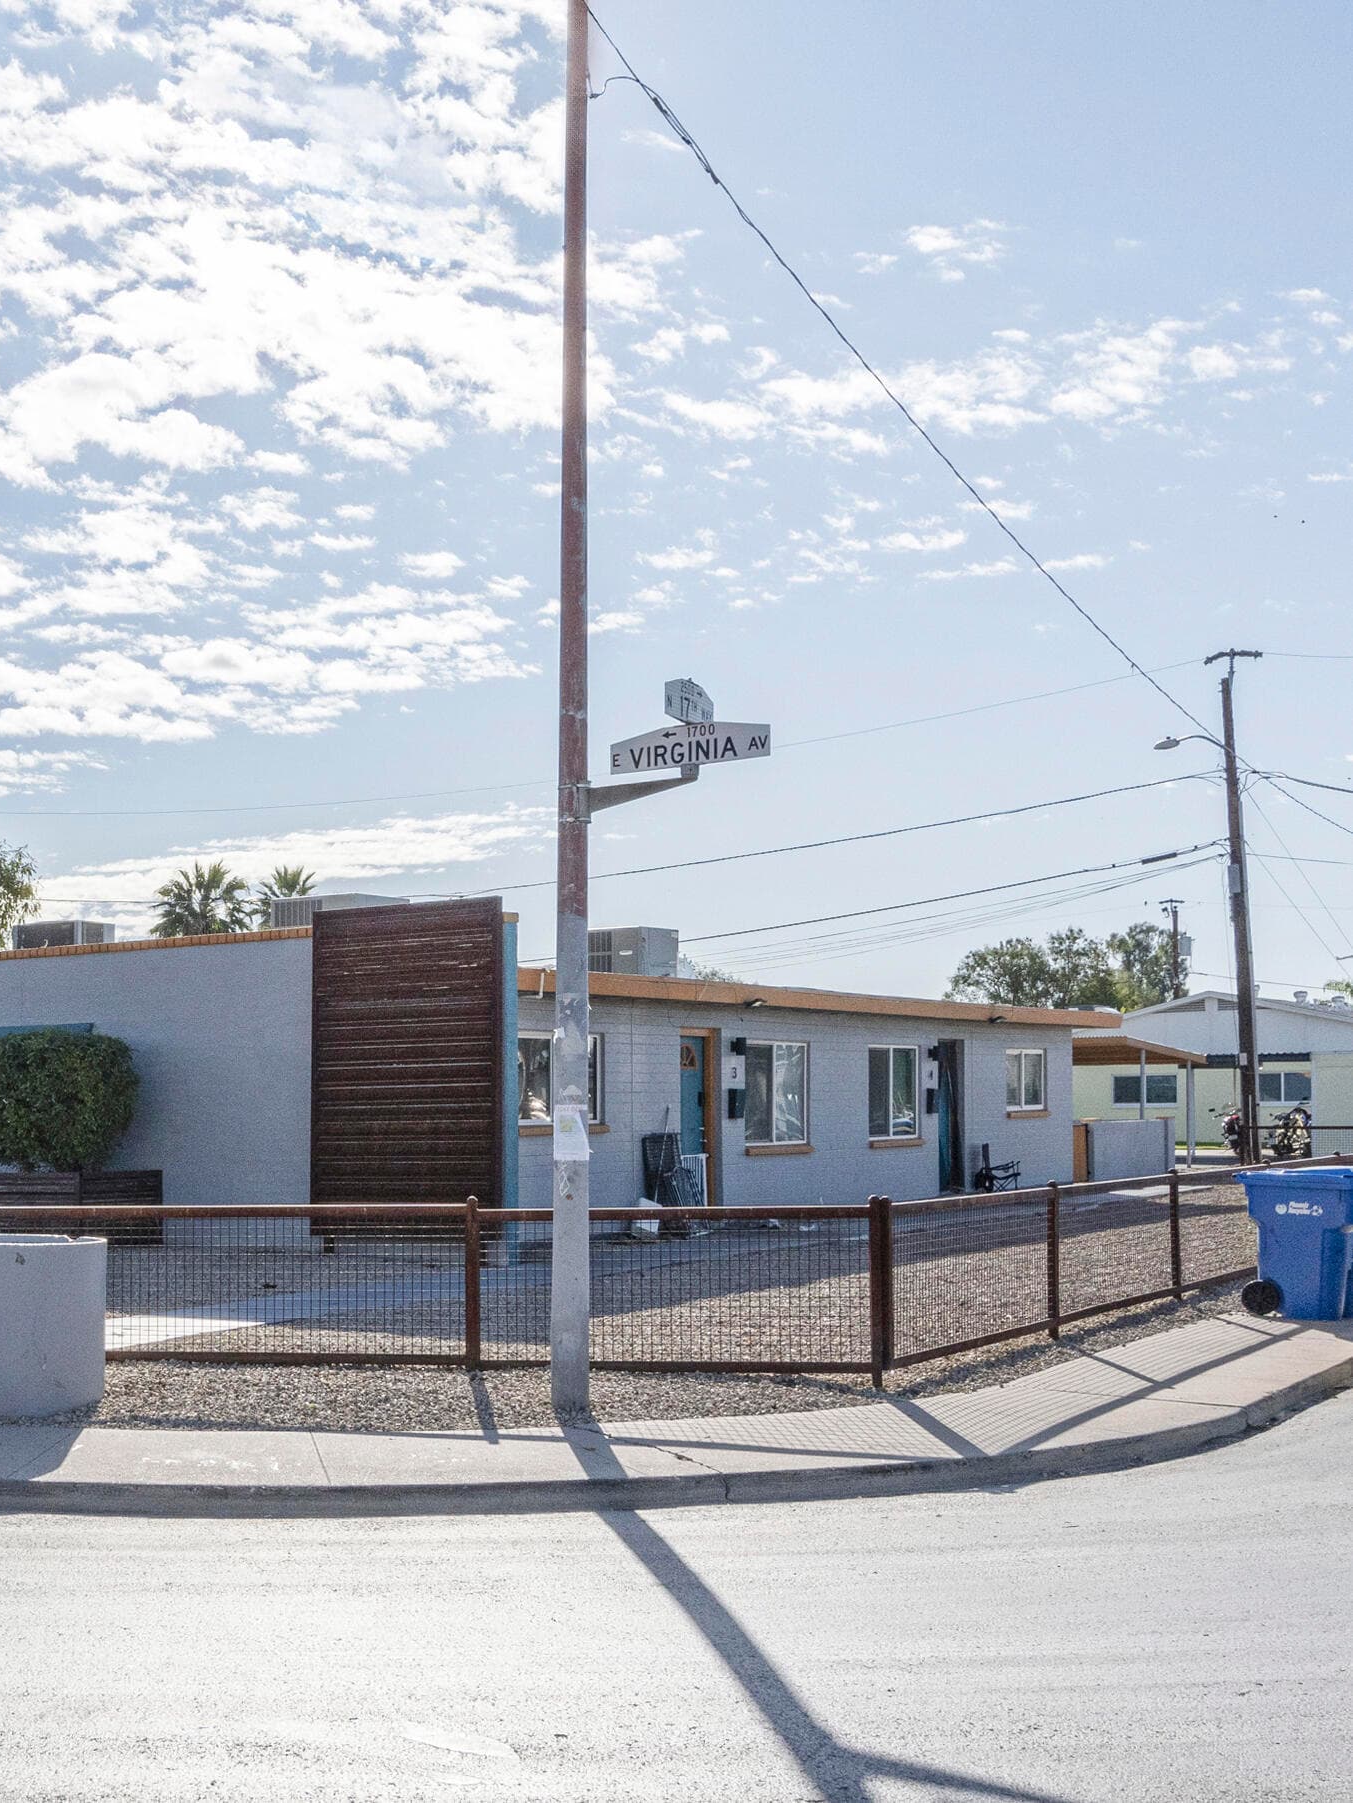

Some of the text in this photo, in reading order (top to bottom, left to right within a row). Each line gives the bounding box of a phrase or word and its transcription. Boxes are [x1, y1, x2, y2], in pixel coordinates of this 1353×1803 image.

[687, 723, 716, 738] 1700
[612, 735, 768, 769] E VIRGINIA AV
[731, 1066, 737, 1079] 3
